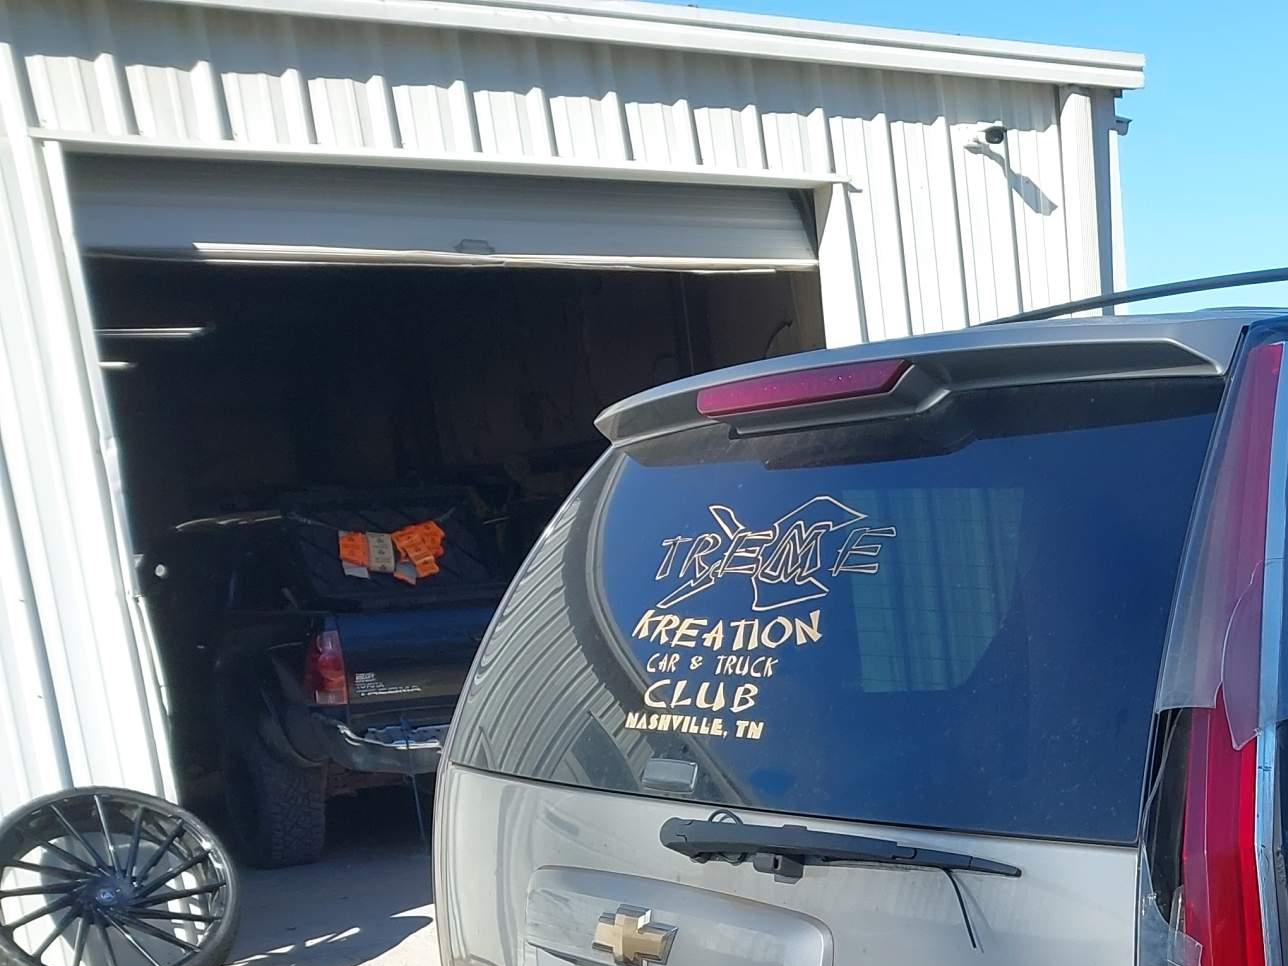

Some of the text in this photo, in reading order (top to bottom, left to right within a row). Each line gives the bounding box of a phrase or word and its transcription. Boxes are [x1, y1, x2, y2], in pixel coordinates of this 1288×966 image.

[632, 609, 823, 651] KREATION
[646, 653, 779, 678] CAR & TRUCK
[644, 679, 759, 713] CLUB
[624, 712, 765, 740] NASHVILLE, TN
